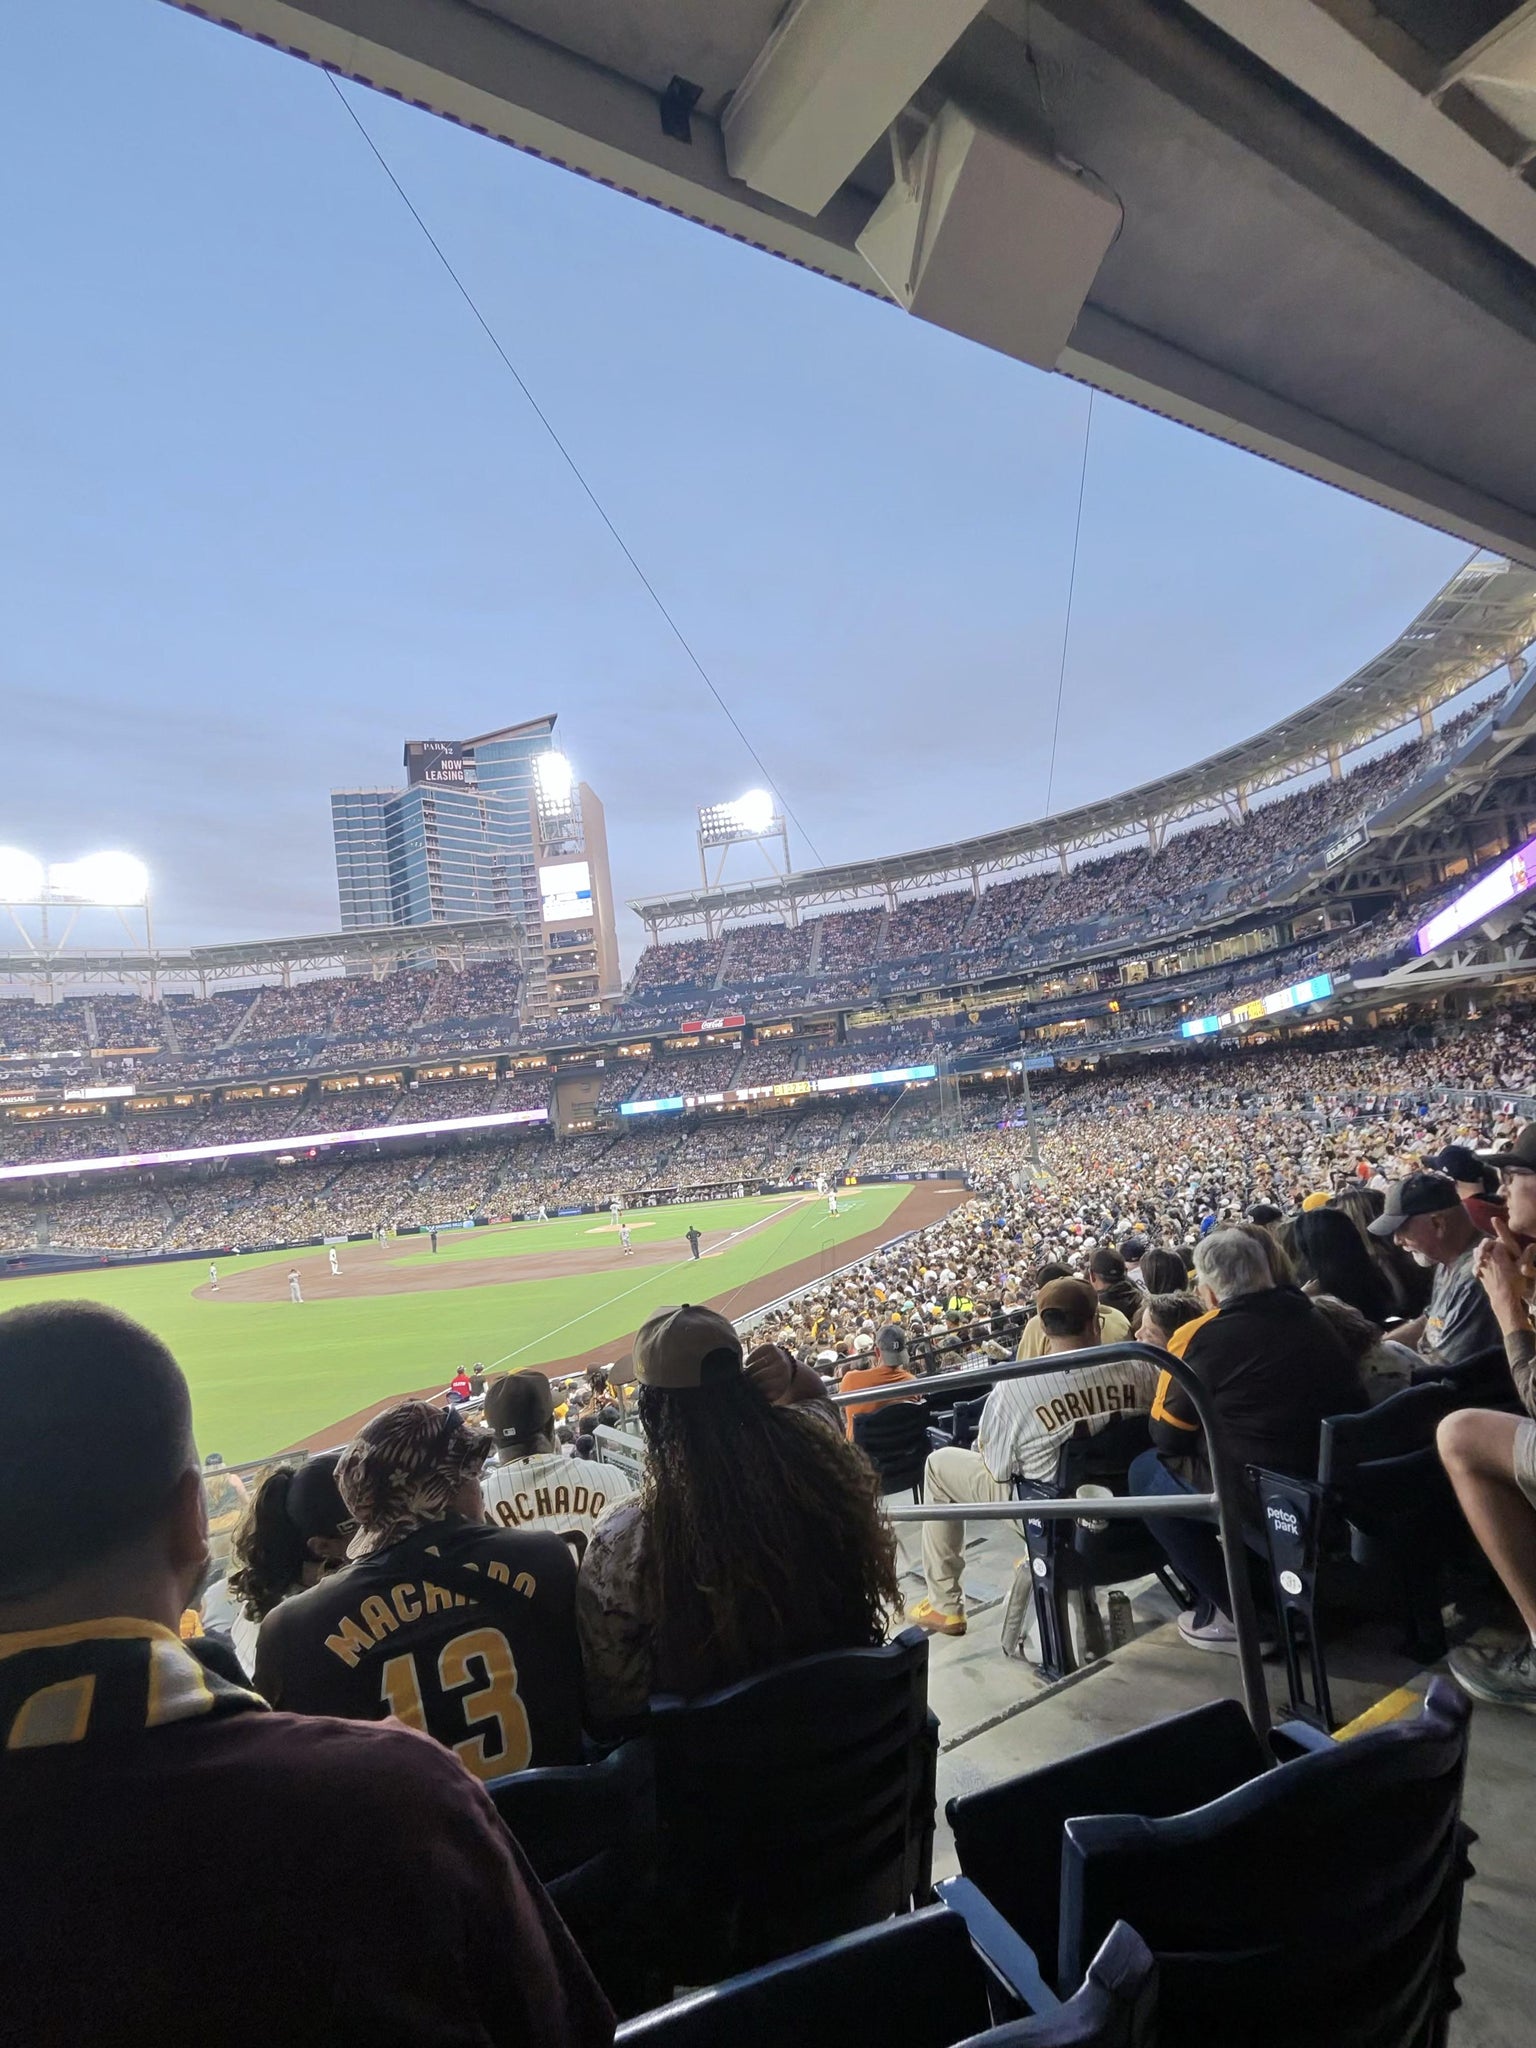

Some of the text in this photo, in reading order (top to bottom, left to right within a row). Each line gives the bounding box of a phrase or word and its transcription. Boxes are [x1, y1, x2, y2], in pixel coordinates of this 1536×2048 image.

[423, 743, 447, 751] PARK
[445, 747, 453, 755] 12
[441, 760, 462, 770] NOW
[425, 771, 464, 781] LEASING
[1035, 936, 1212, 983] JERRY COLEMAN BROADCAST CENTER
[1034, 1383, 1136, 1432] DARVISH
[484, 1485, 606, 1528] ACHADO
[1266, 1506, 1298, 1525] petco
[1274, 1518, 1300, 1536] park
[379, 1626, 533, 1784] 13
